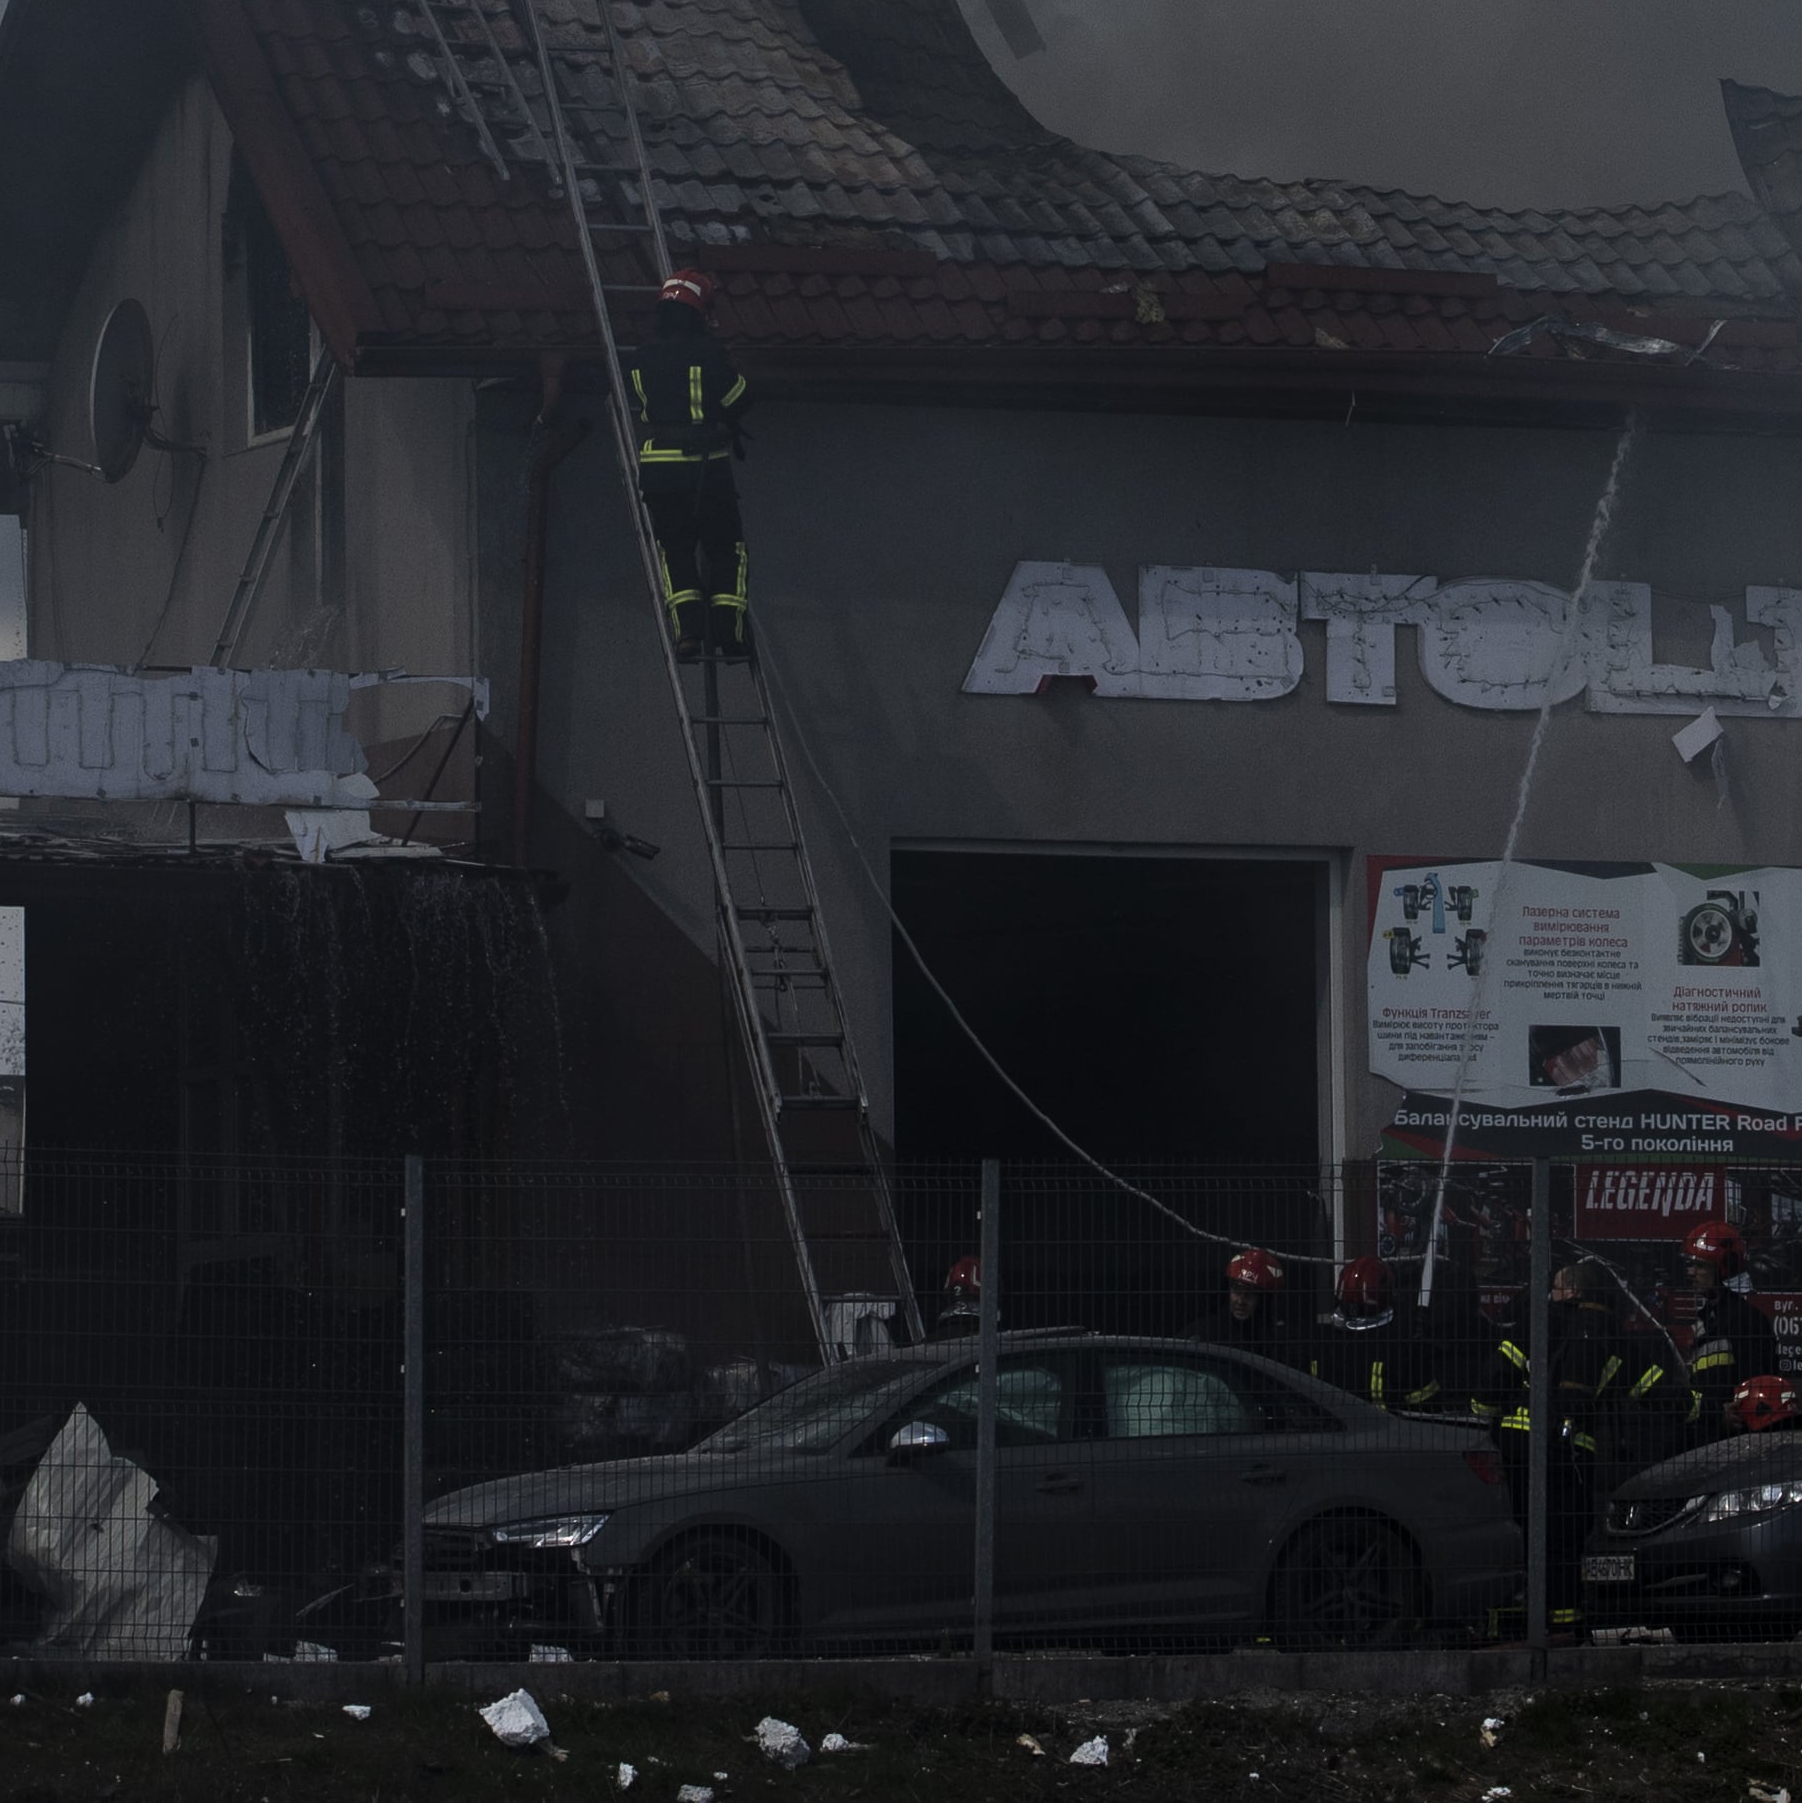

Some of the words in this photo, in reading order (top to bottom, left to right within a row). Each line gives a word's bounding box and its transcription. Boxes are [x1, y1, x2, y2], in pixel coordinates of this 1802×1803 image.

[1523, 906, 1569, 918] Лазерна
[1572, 909, 1620, 919] система
[1533, 922, 1609, 933] вимірювання
[1519, 936, 1585, 948] параметрів
[1589, 938, 1628, 948] колеса
[1524, 949, 1559, 958] виконує
[1561, 948, 1621, 958] безконтактне
[1507, 959, 1555, 968] сканування
[1557, 960, 1595, 968] поверхні
[1597, 961, 1626, 969] колеса
[1528, 970, 1555, 978] точно
[1557, 970, 1594, 978] визначає
[1597, 971, 1621, 980] місце
[1504, 980, 1563, 989] прикріплення
[1566, 981, 1602, 990] тягарців
[1611, 982, 1642, 990] нижній
[1544, 992, 1579, 1000] мертвій
[1581, 992, 1605, 1000] точці
[1674, 986, 1761, 998] Діагностичний
[1673, 1002, 1728, 1012] натяжний
[1732, 1002, 1767, 1013] ролик
[1383, 1008, 1427, 1020] Функція
[1430, 1007, 1491, 1019] Tranzser
[1651, 1014, 1684, 1022] Виявляє
[1686, 1013, 1719, 1023] вібрації
[1721, 1016, 1769, 1024] недоступні
[1771, 1016, 1785, 1024] для
[1373, 1020, 1411, 1030] Вимірює
[1413, 1022, 1443, 1030] висоту
[1445, 1022, 1499, 1030] протктора
[1663, 1024, 1706, 1032] звичайних
[1709, 1025, 1777, 1034] балансувальних
[1405, 1031, 1417, 1040] під
[1720, 1037, 1757, 1045] мінімізує
[1759, 1037, 1789, 1045] бокове
[1389, 1043, 1403, 1051] для
[1405, 1043, 1457, 1051] запобігання
[1663, 1046, 1709, 1054] відведення
[1711, 1047, 1760, 1055] автомобіля
[1762, 1048, 1775, 1056] від
[1676, 1056, 1743, 1066] прямолінійного
[1745, 1058, 1765, 1066] руху
[1574, 1114, 1633, 1129] стенд
[1641, 1114, 1731, 1130] HUNTER
[1737, 1115, 1787, 1132] Road
[1581, 1135, 1625, 1150] 5-го
[1631, 1136, 1733, 1152] покоління
[1585, 1170, 1715, 1217] LEGENDA
